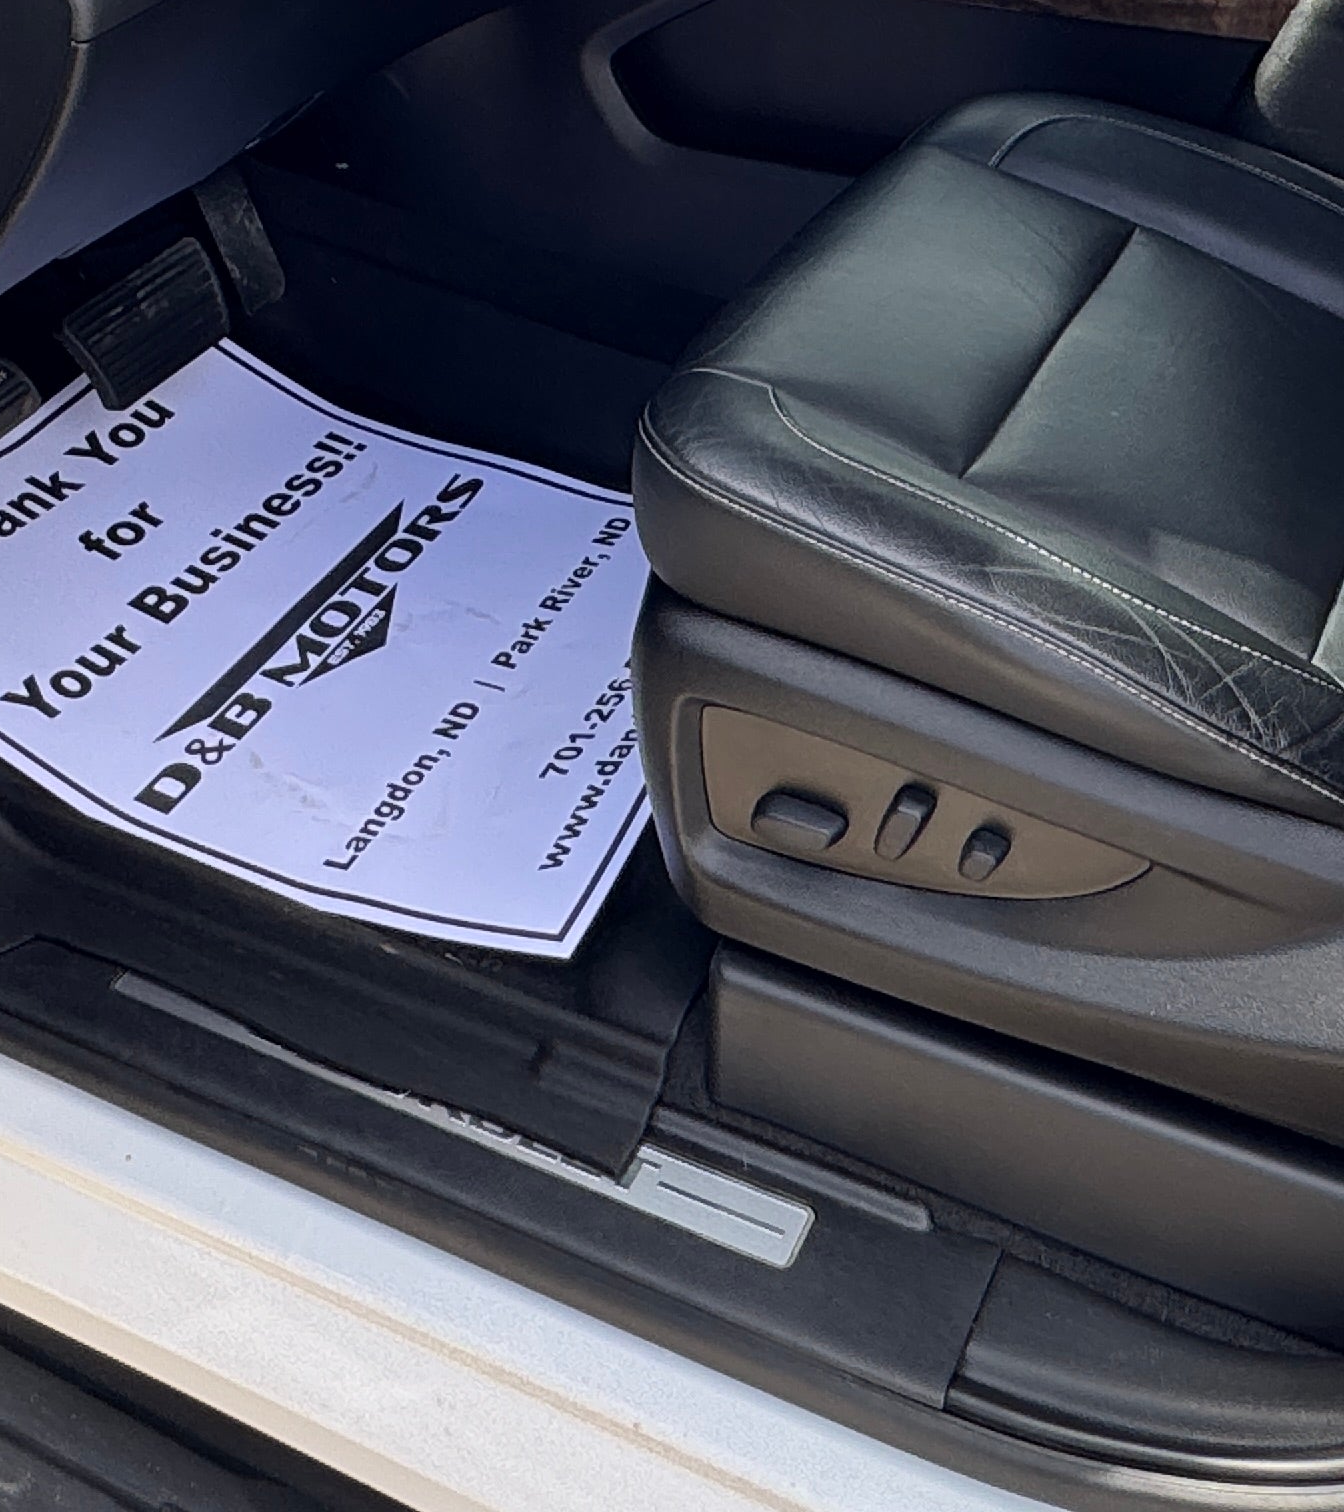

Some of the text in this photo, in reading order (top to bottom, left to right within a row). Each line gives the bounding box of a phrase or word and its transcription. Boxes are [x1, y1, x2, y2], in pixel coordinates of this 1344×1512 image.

[63, 399, 175, 466] You
[79, 501, 163, 561] for
[127, 431, 367, 625] Business!!
[133, 473, 484, 815] D&B MOTORS
[323, 747, 452, 871] Langdon,
[433, 701, 480, 740] ND
[490, 616, 553, 670] Park
[539, 554, 612, 612] River,
[592, 517, 632, 547] ND
[539, 658, 633, 780] 701-256
[538, 726, 639, 872] www.dan
